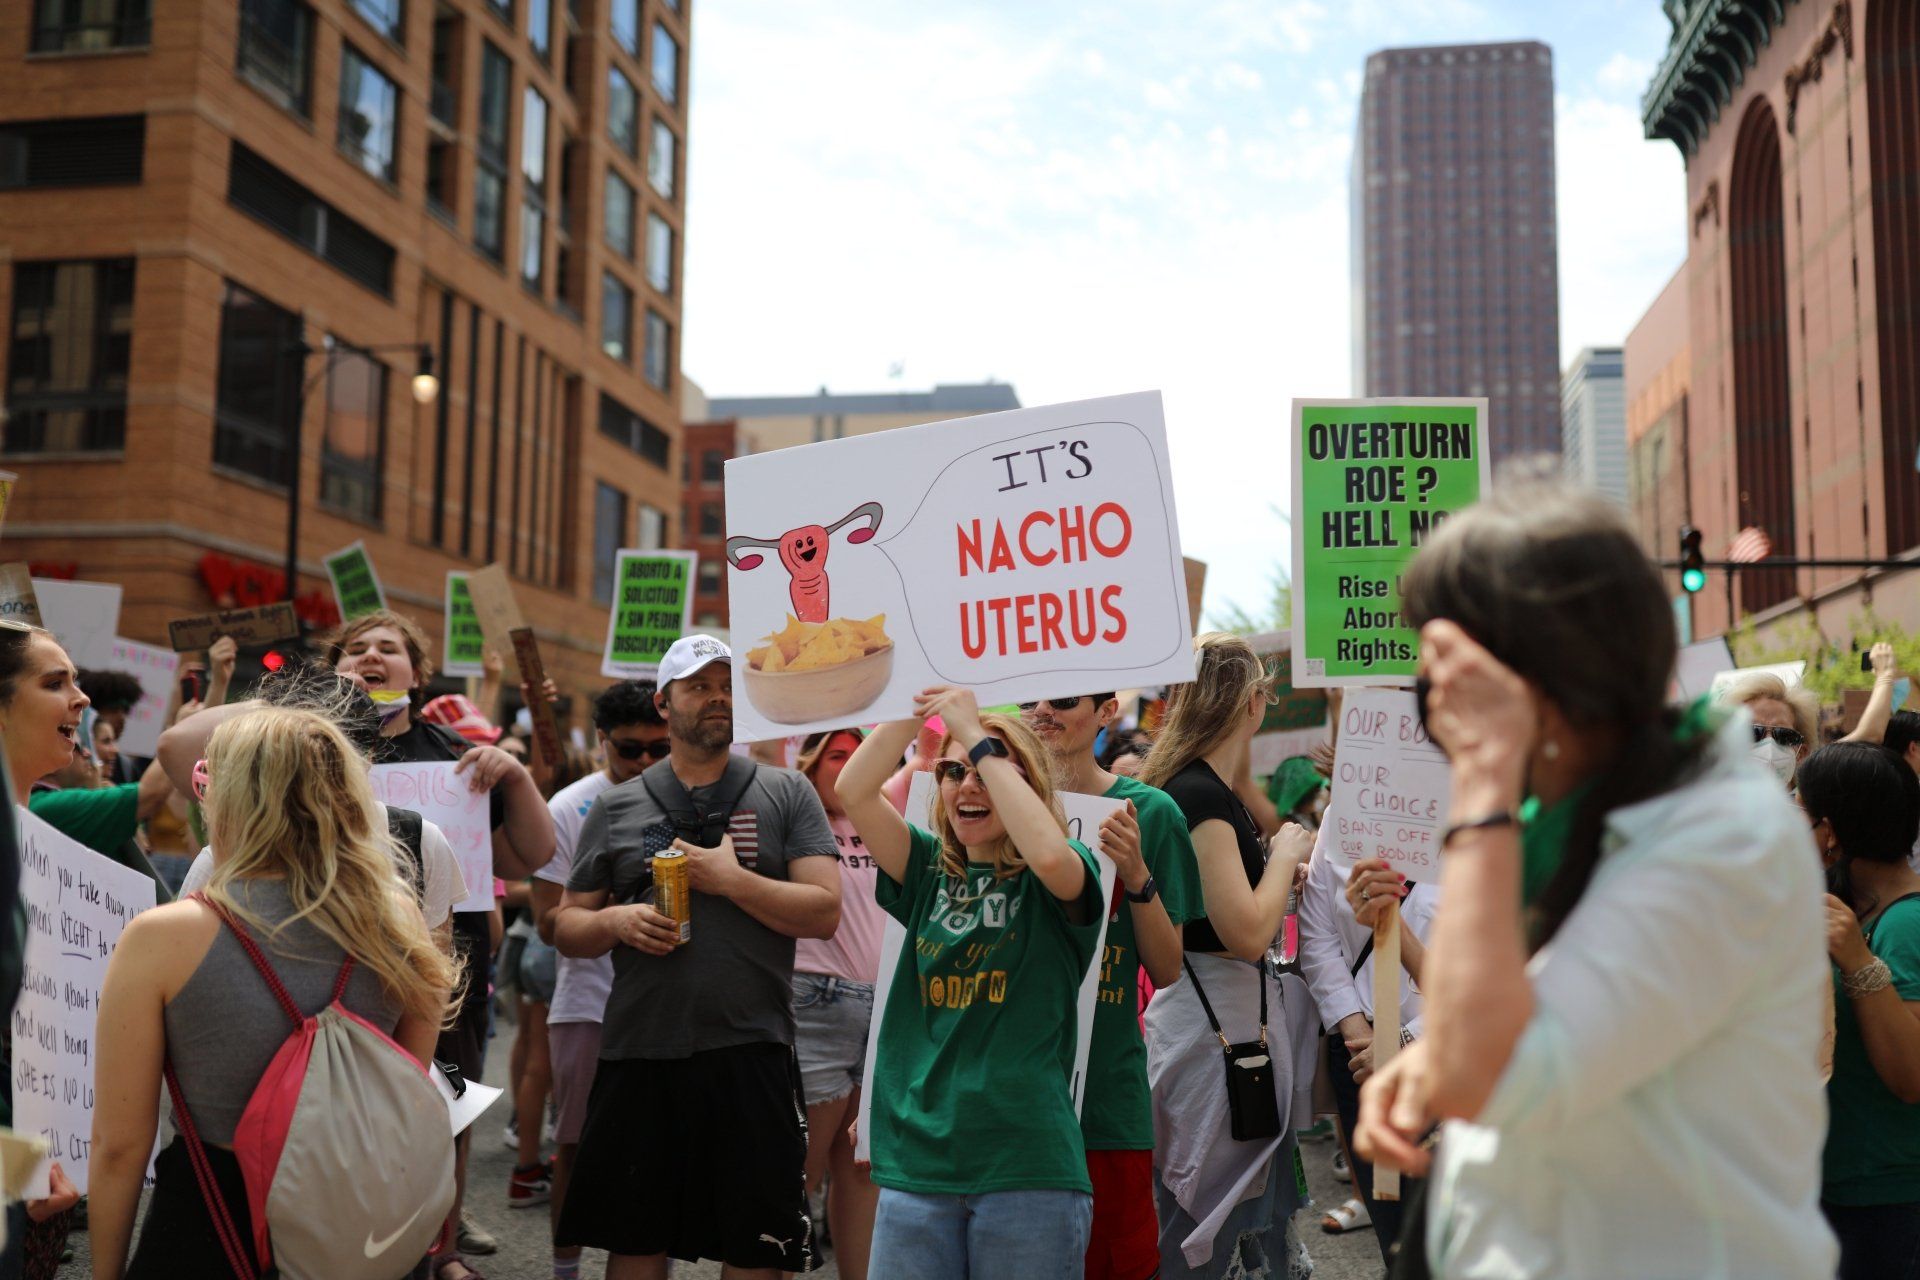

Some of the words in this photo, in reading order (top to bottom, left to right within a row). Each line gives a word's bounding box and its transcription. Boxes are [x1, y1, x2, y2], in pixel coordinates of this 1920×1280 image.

[1309, 422, 1472, 461] OVERTURN
[992, 440, 1092, 492] IT'S
[1345, 465, 1406, 504] ROE
[957, 502, 1132, 577] NACHO
[1322, 509, 1399, 549] HELL
[624, 586, 678, 606] SOLICITUD
[1338, 575, 1389, 598] Rise
[627, 611, 644, 628] SIN
[648, 611, 681, 630] PEDIR
[960, 584, 1127, 659] UTERUS
[1337, 637, 1418, 667] Rights.
[1346, 707, 1388, 738] OUR
[1340, 763, 1390, 787] OUR
[1357, 788, 1438, 818] CHOICE
[1338, 817, 1384, 836] BANS
[1397, 828, 1431, 844] OFF
[1341, 840, 1363, 851] OUR
[20, 820, 50, 880] When
[58, 866, 72, 904] you
[78, 871, 100, 905] take
[105, 892, 126, 930] away
[61, 911, 92, 949] RIGHT
[98, 930, 107, 958] to
[65, 981, 89, 1011] about
[17, 1059, 38, 1094] SHE
[42, 1073, 56, 1101] IS
[63, 1078, 77, 1105] NO
